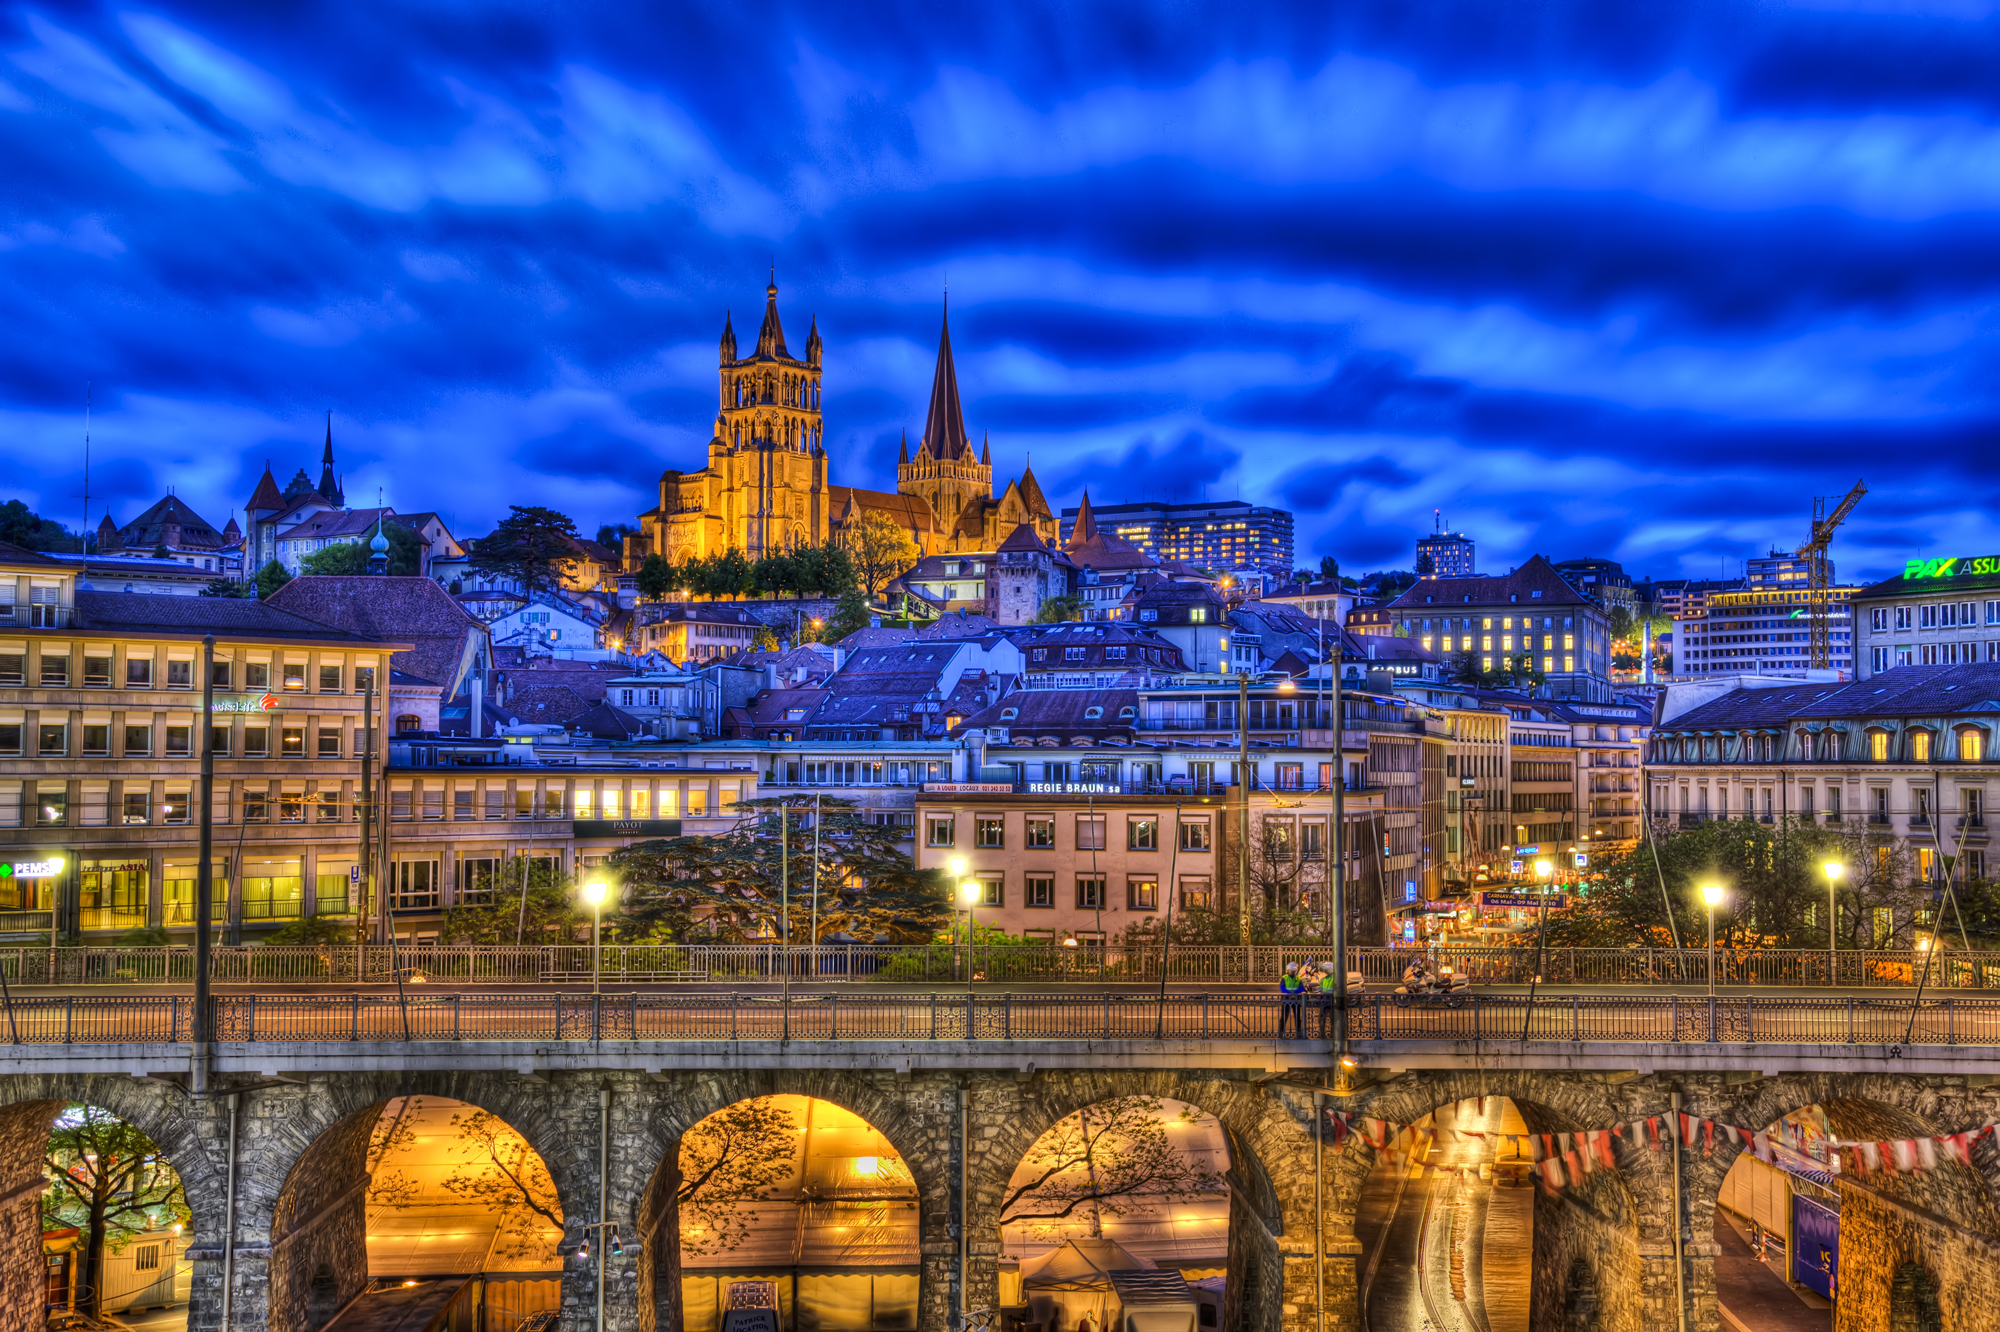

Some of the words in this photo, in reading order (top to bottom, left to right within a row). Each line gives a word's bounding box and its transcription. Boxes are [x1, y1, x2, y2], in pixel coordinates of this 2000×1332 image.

[1903, 557, 1957, 580] PAX
[1960, 558, 2000, 575] ASSU
[210, 701, 256, 712] wissLife
[1030, 783, 1062, 793] REGIE
[1066, 783, 1104, 793] BRAUN
[1108, 785, 1121, 793] sa
[613, 821, 643, 829] PAYOT
[14, 863, 53, 875] PEMS
[120, 863, 146, 871] ASIA
[735, 1315, 766, 1326] PATRICK
[733, 1323, 769, 1332] LOCATION
